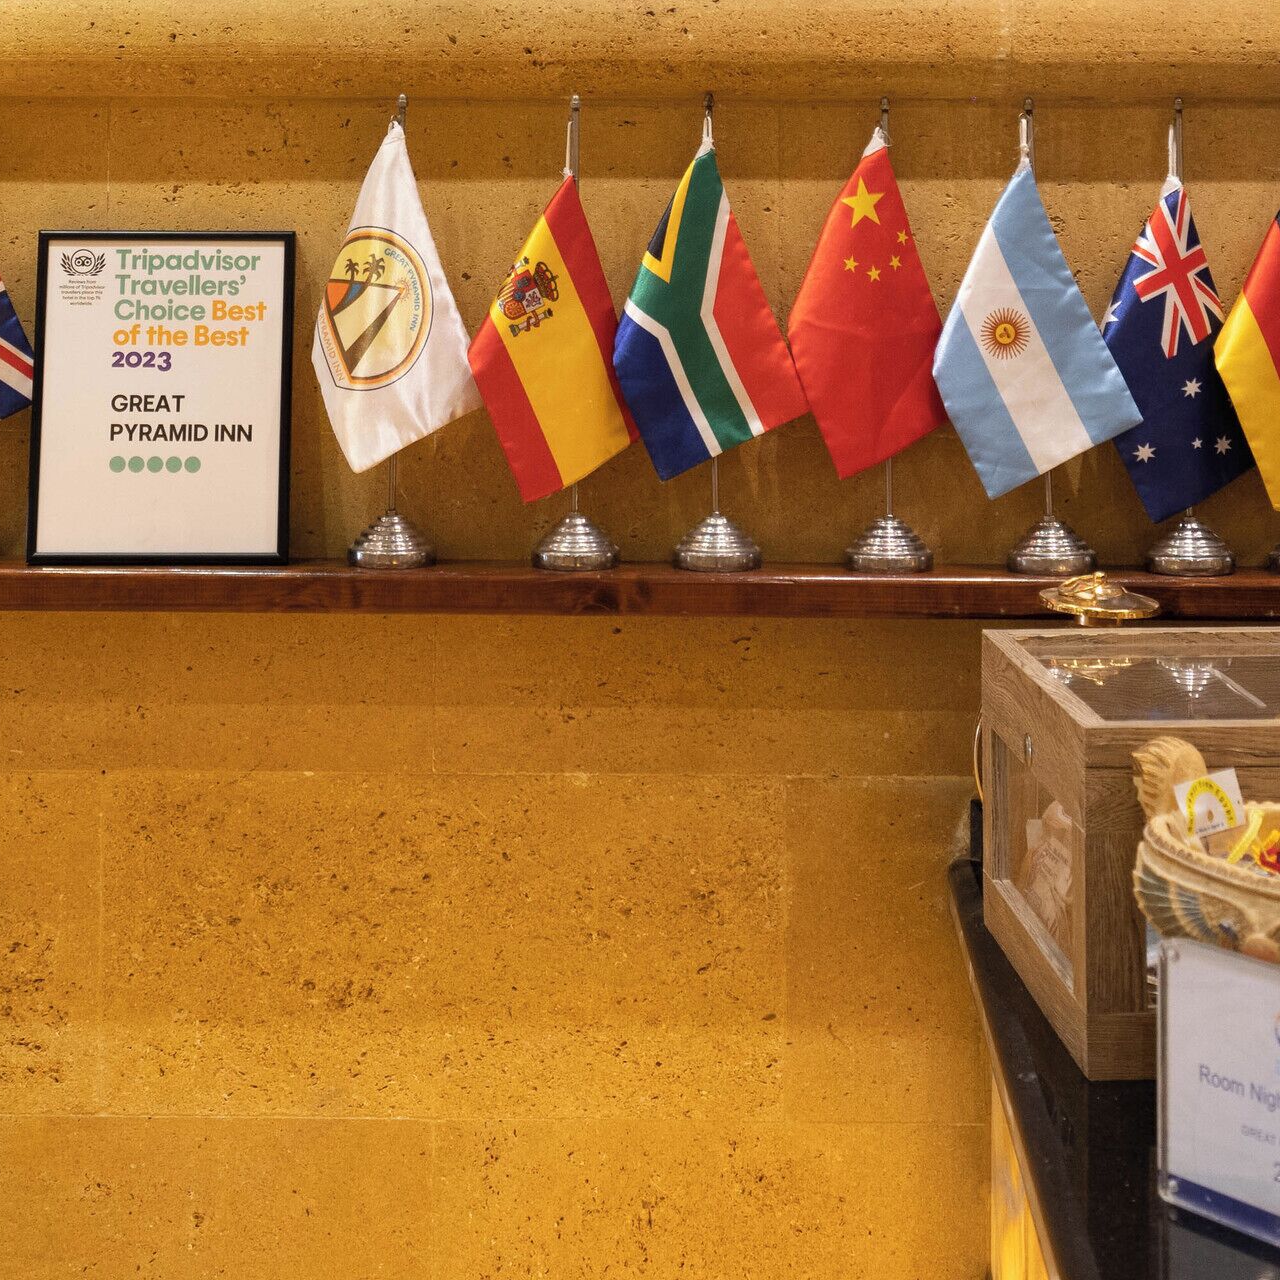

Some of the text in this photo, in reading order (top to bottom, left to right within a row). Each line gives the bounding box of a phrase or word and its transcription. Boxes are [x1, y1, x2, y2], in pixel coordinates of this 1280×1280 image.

[115, 248, 260, 275] Tripadvisor
[384, 247, 421, 332] GREAT PYRAMID INN
[114, 299, 267, 322] Choice Best
[112, 324, 250, 346] of the Best
[111, 351, 172, 372] 2023
[110, 394, 185, 413] GREAT
[109, 424, 252, 442] PYRAMID INN
[1199, 1063, 1245, 1098] Room
